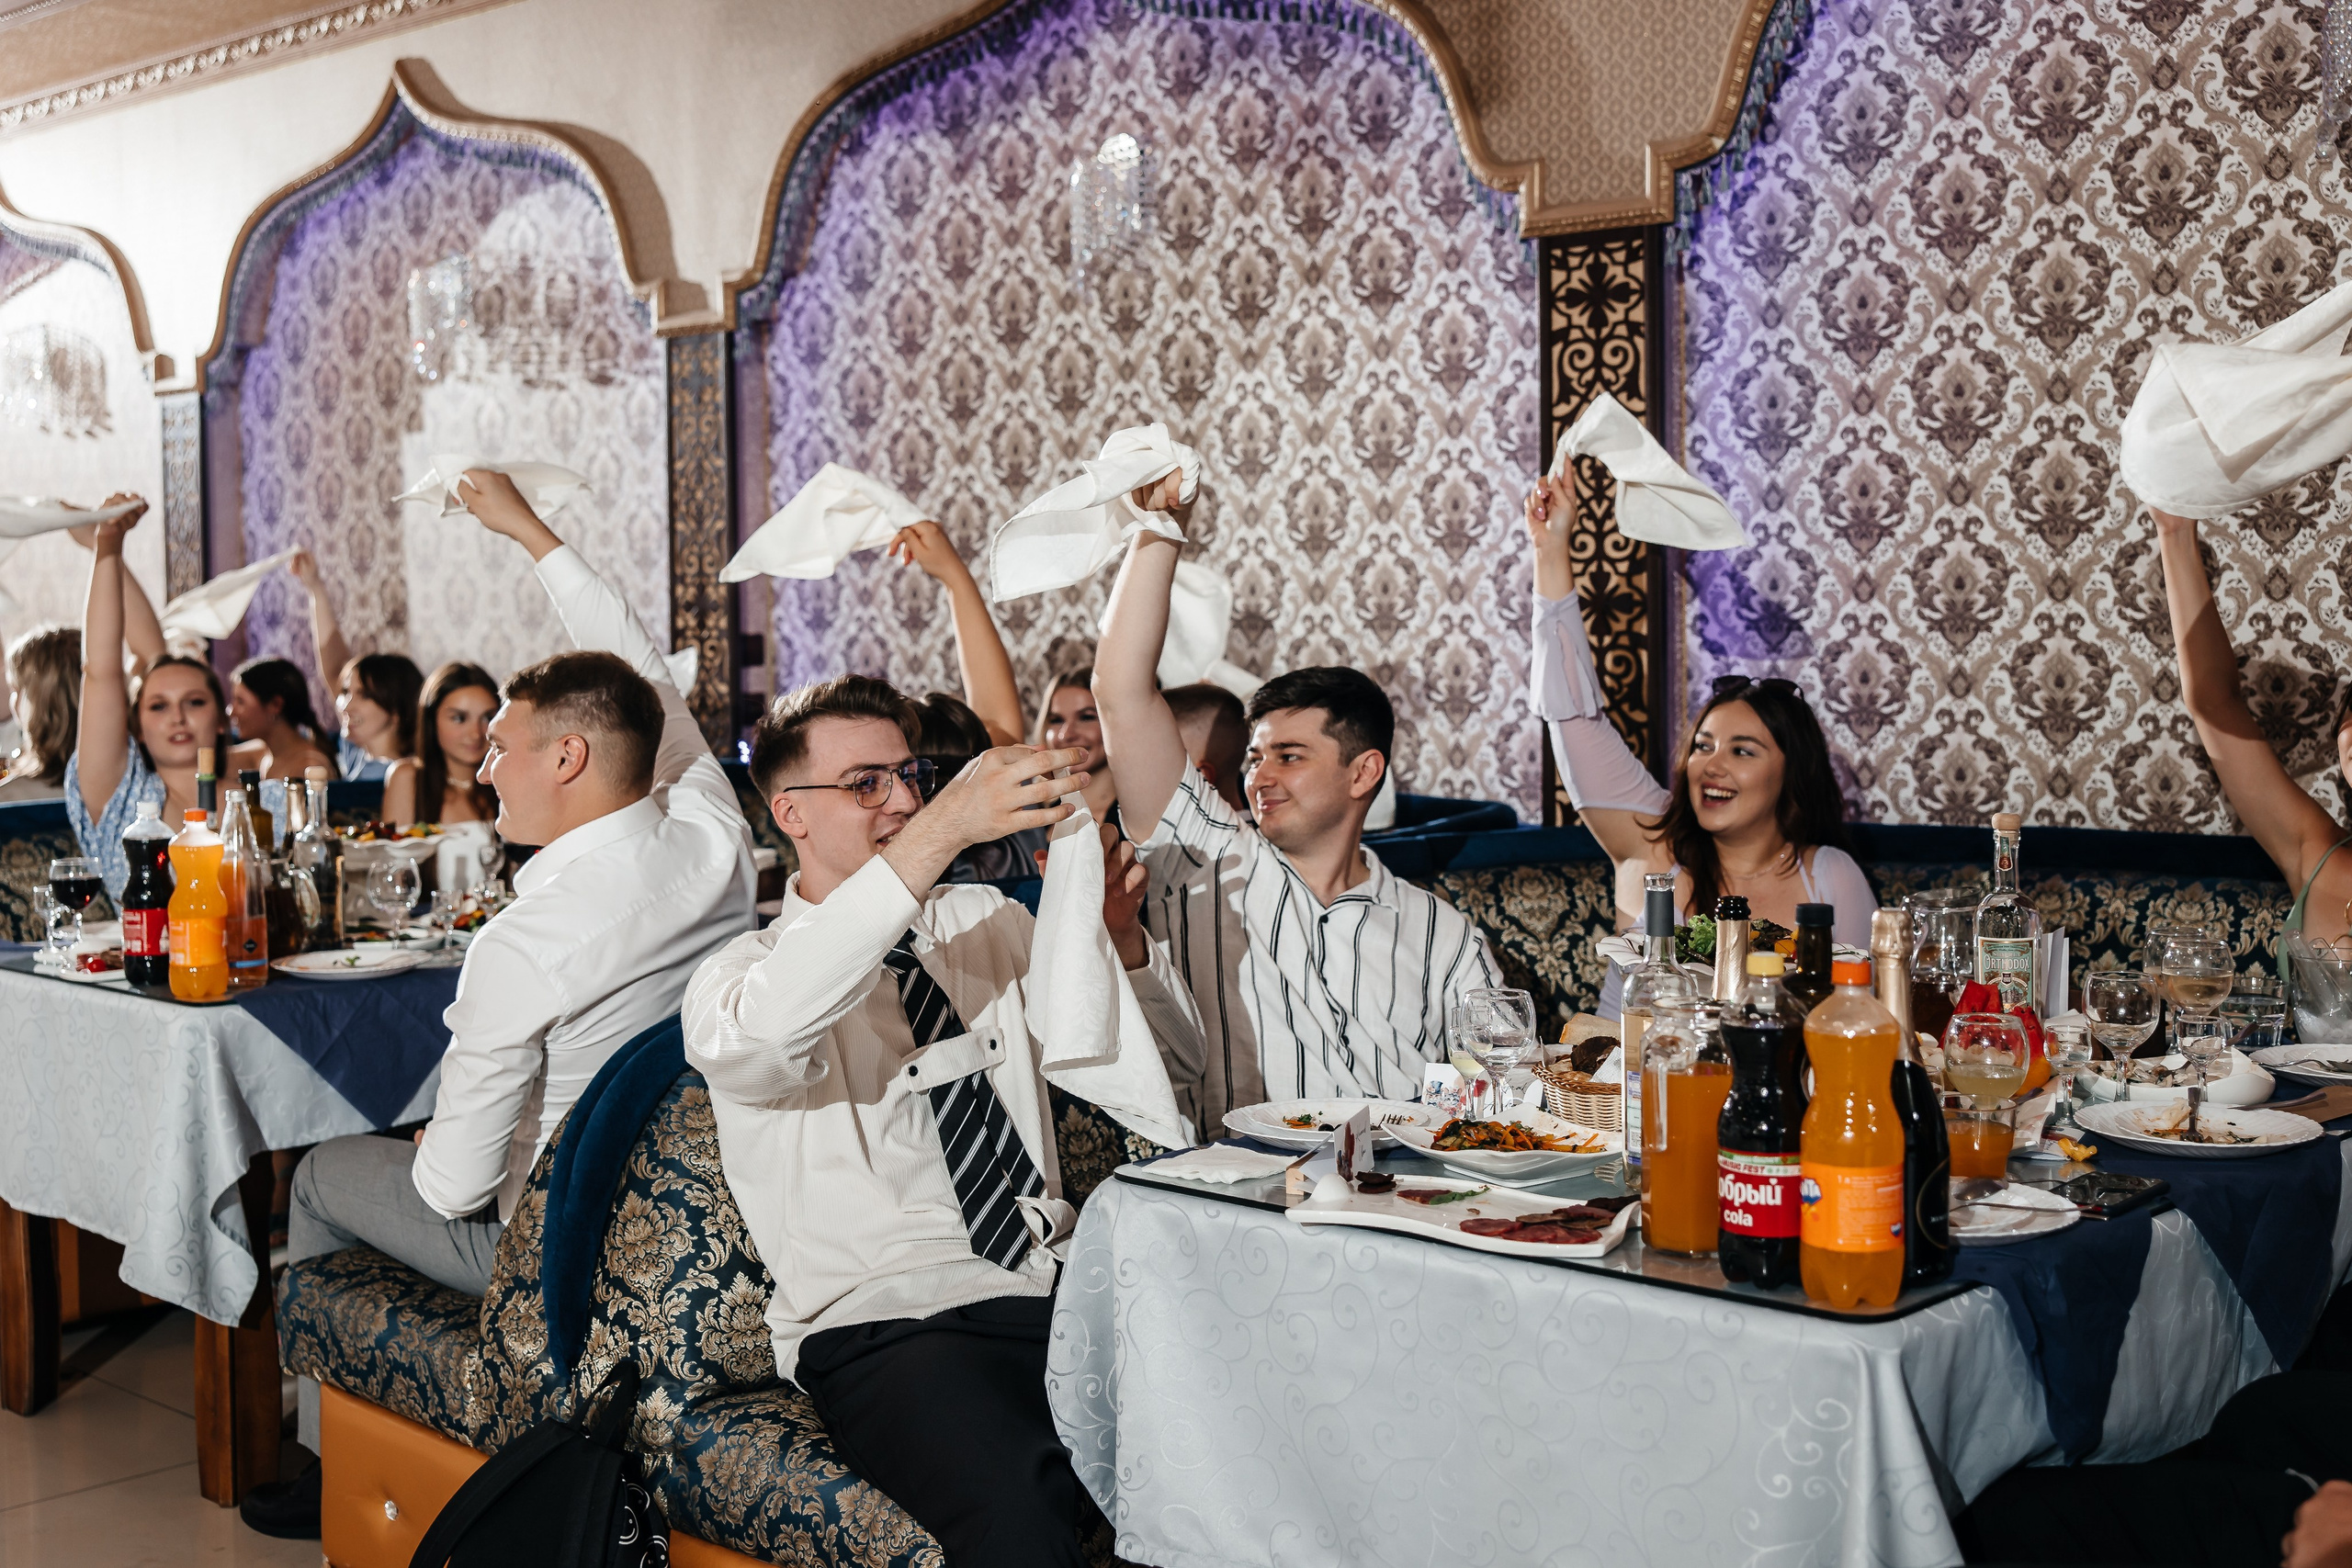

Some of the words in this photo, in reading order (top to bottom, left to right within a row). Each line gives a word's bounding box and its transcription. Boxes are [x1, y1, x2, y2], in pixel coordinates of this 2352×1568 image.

[1984, 953, 2030, 972] ORTHODOX
[1743, 1164, 1765, 1173] FEST
[1719, 1173, 1782, 1207] обрый
[1724, 1209, 1753, 1227] cola
